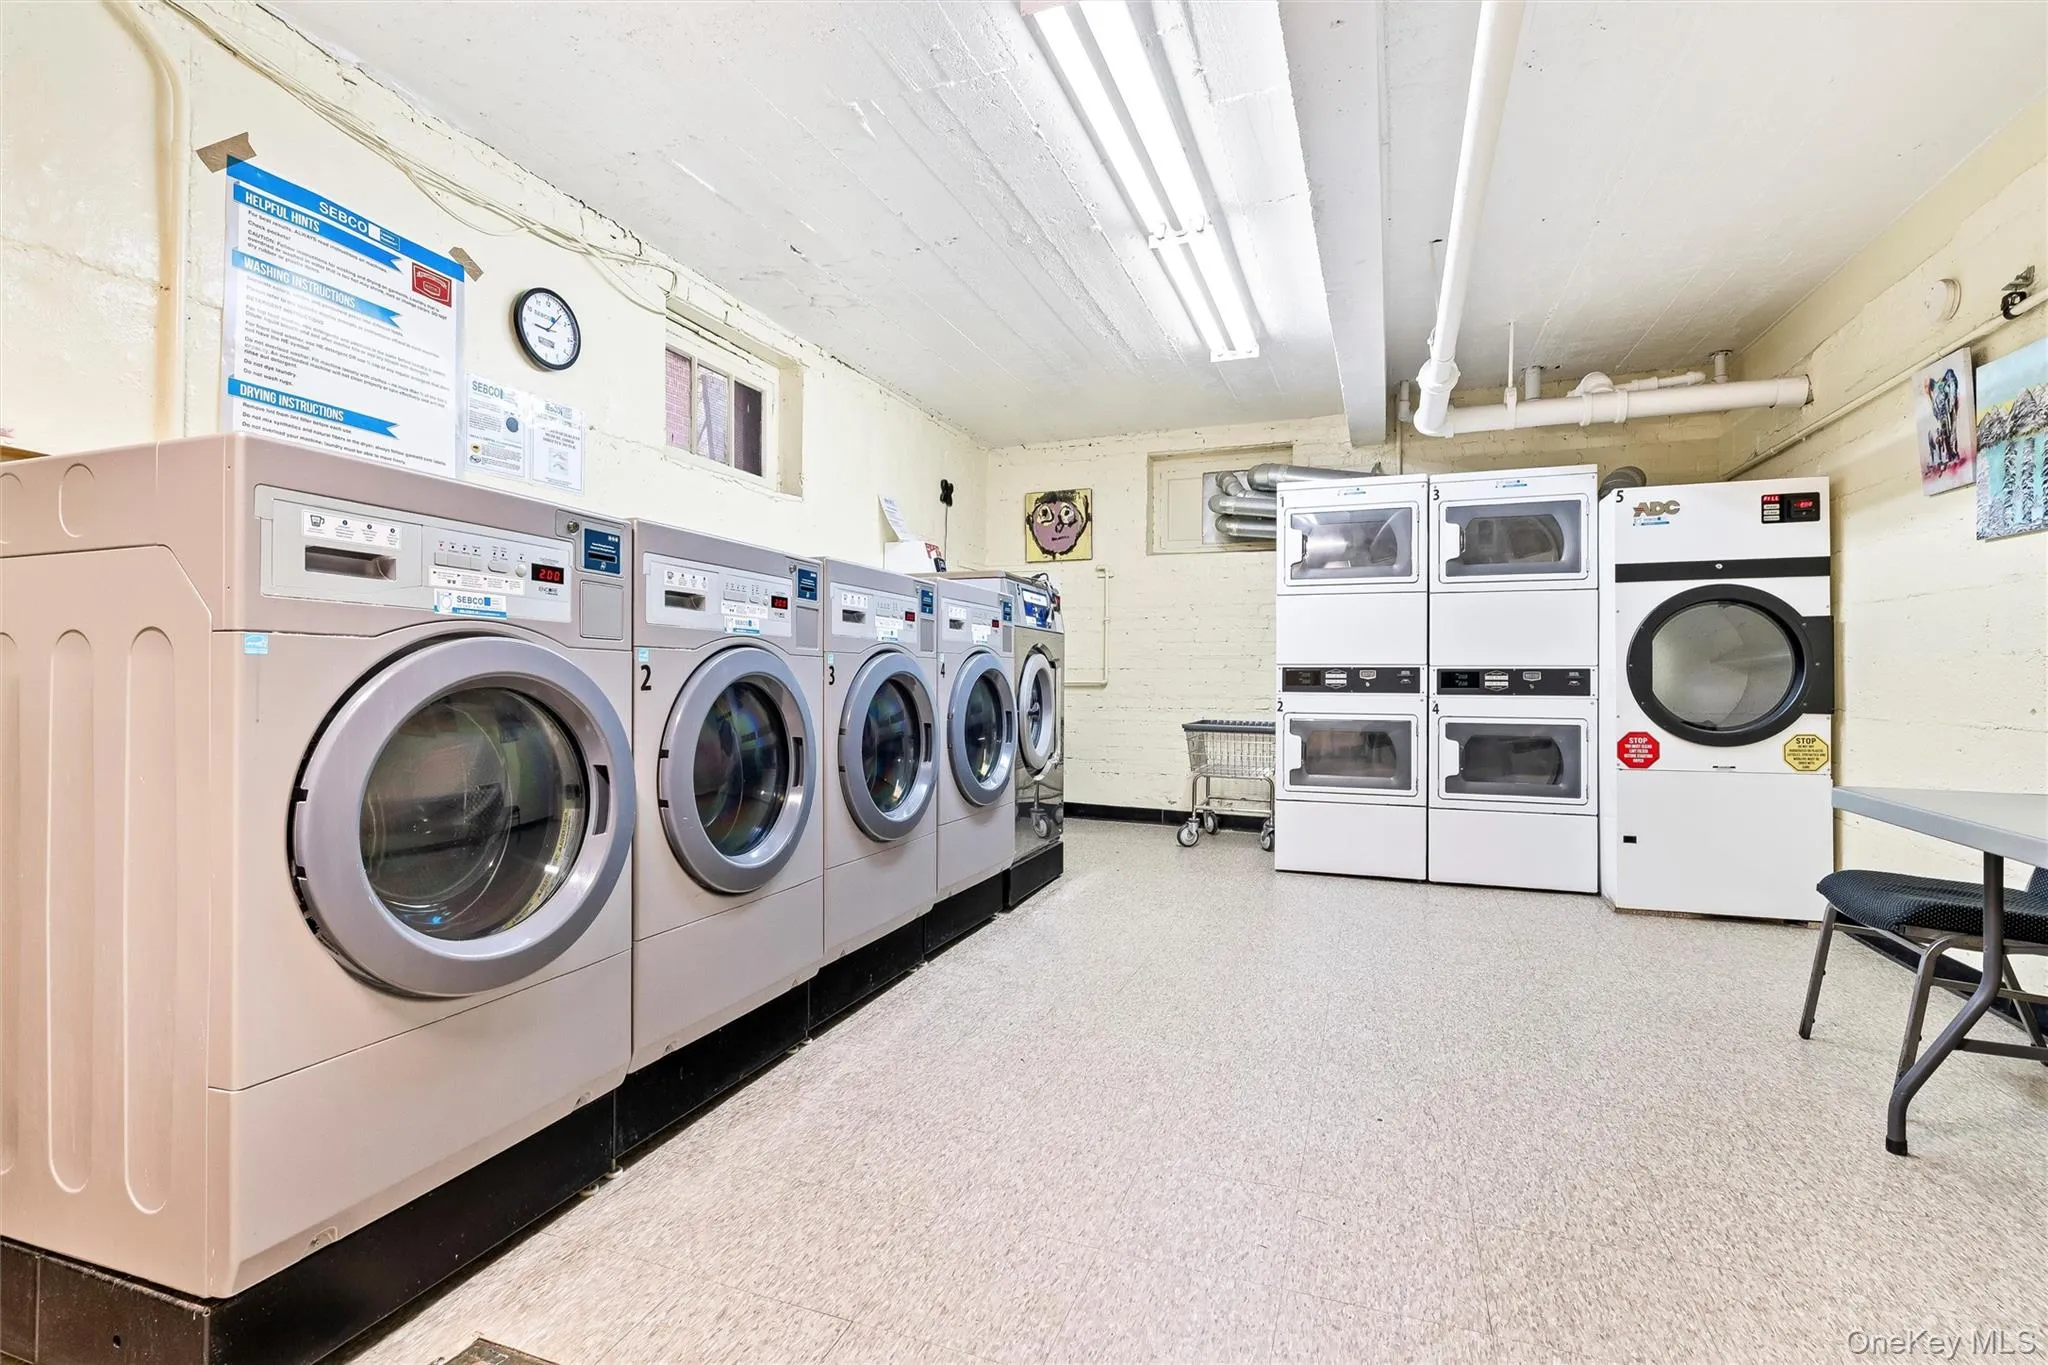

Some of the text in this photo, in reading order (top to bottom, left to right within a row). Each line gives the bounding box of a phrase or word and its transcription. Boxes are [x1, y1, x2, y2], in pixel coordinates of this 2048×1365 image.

[245, 191, 320, 233] HELPFUL HINTS
[319, 201, 368, 233] SEBCO
[247, 218, 265, 231] Check
[247, 241, 256, 249] dry
[244, 255, 290, 284] WASHING
[292, 273, 356, 310] INSTRUCTIONS
[243, 357, 252, 365] Do
[253, 360, 262, 368] not
[263, 363, 274, 372] dye
[263, 373, 278, 382] wash
[472, 381, 501, 399] SEBCO
[240, 383, 344, 421] DRYING INSTRUCTIONS
[242, 401, 265, 412] Remove
[242, 410, 250, 418] Do
[241, 420, 250, 428] Do
[1433, 489, 1440, 501] 3
[1616, 489, 1624, 503] 5
[1280, 496, 1284, 508] 1
[1632, 499, 1681, 517] ADC
[456, 595, 484, 606] SEBCO
[828, 665, 835, 686] 3
[940, 663, 945, 679] 4
[640, 664, 652, 692] 2
[1277, 700, 1284, 712] 2
[1431, 703, 1440, 715] 4
[1795, 737, 1817, 745] STOP
